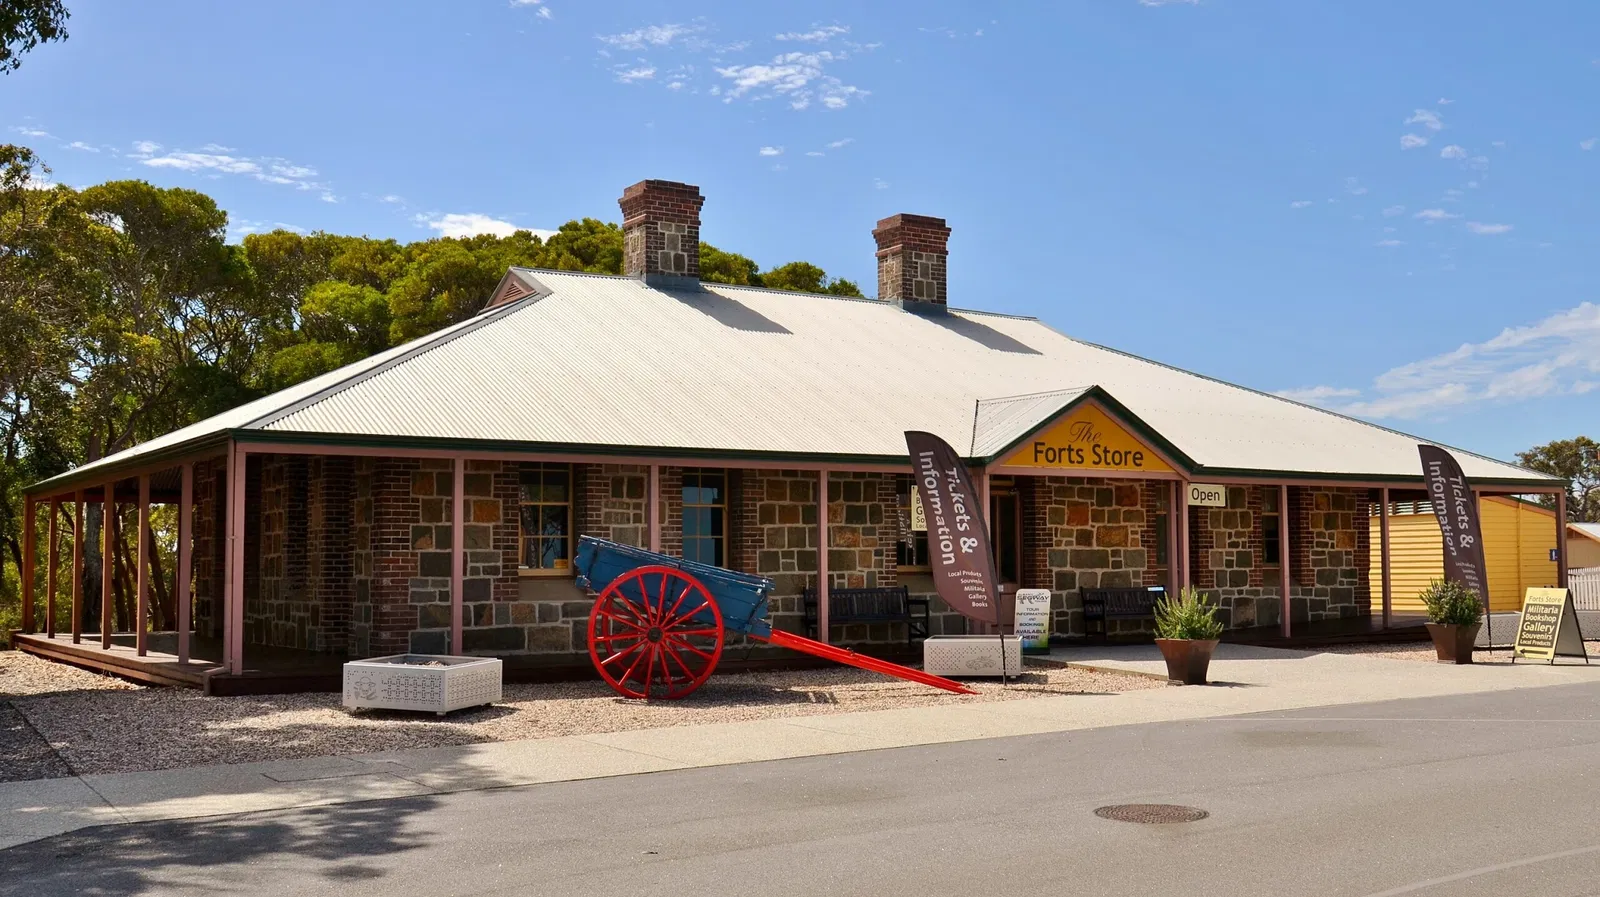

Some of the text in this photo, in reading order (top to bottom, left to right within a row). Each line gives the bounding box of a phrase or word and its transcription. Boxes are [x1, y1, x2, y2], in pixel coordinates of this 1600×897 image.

[1068, 421, 1102, 442] The
[1034, 442, 1144, 467] Forts Store
[1191, 487, 1220, 506] Open
[1450, 476, 1469, 529] Tickets
[919, 451, 955, 565] Information
[945, 468, 978, 554] Tickets &
[1429, 461, 1457, 556] Information
[1459, 534, 1474, 548] &
[1525, 614, 1557, 623] Bookshop
[1527, 605, 1558, 614] Militaria
[1521, 632, 1553, 640] Souvenirs
[1523, 622, 1555, 633] Gallery
